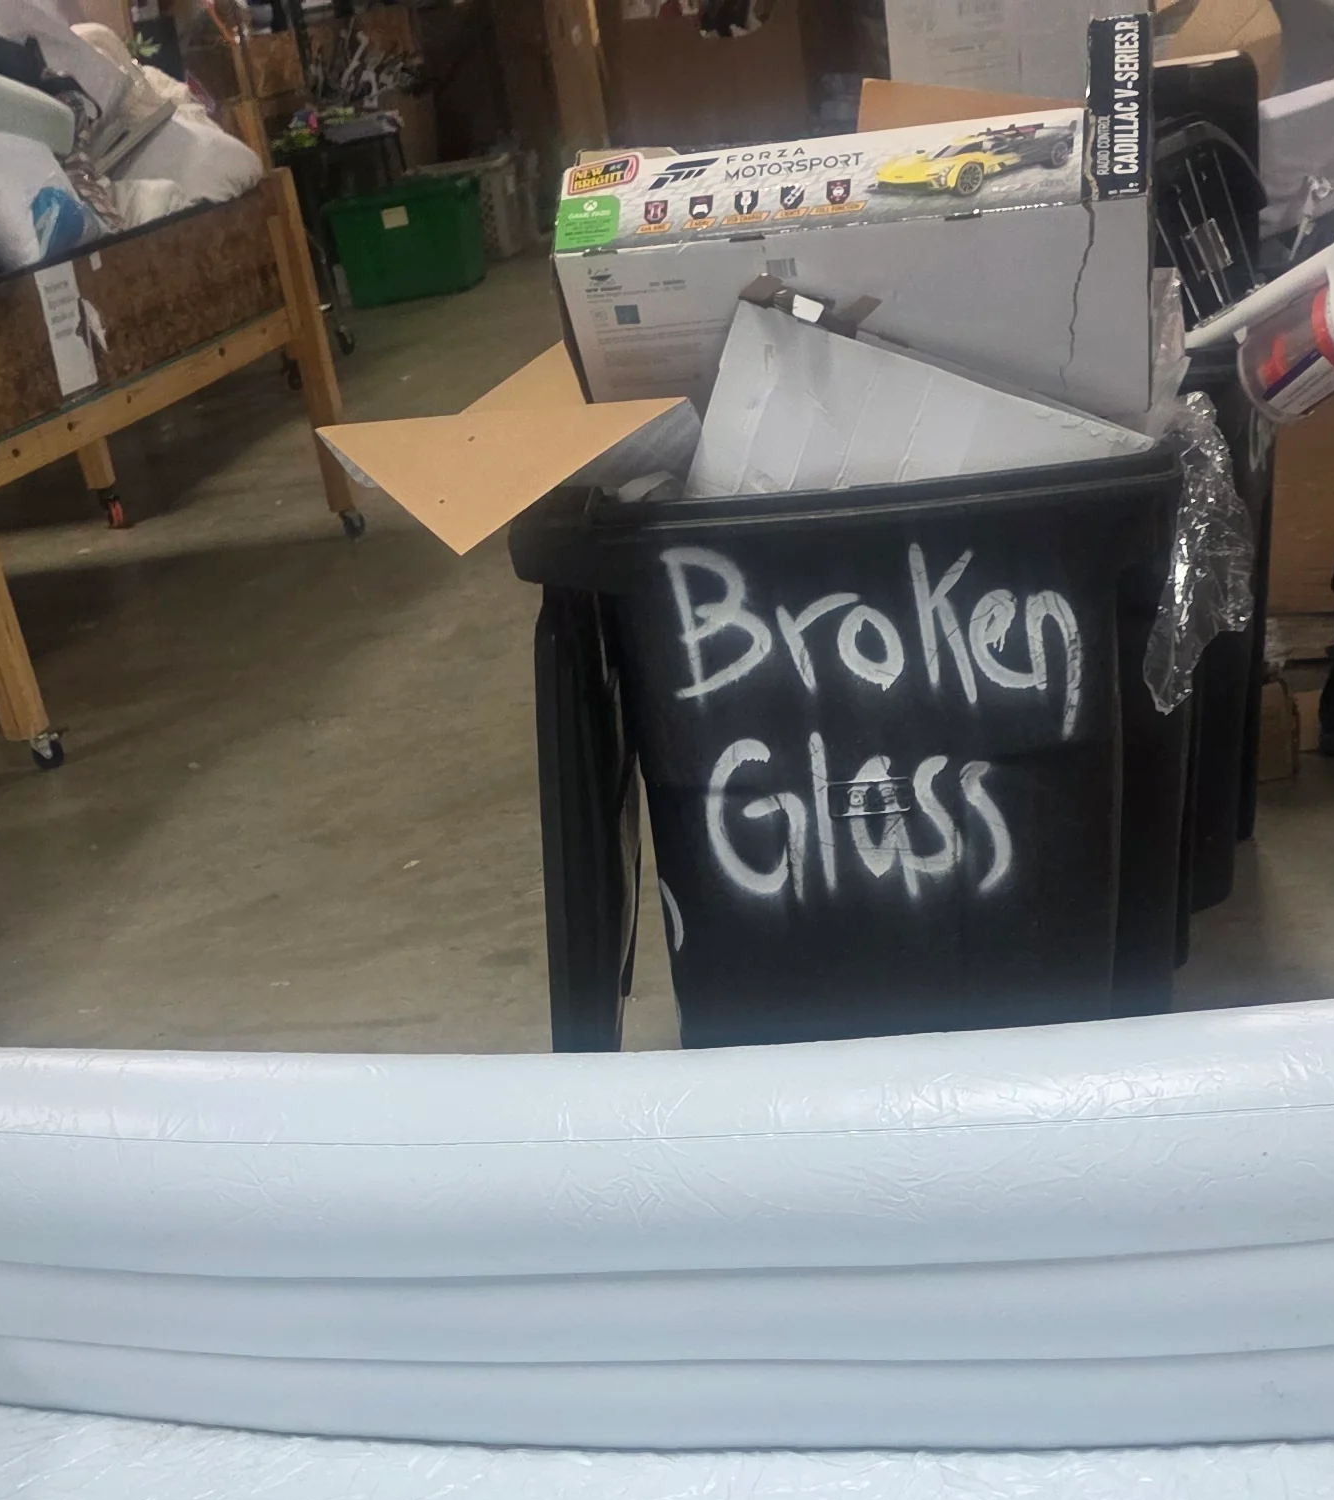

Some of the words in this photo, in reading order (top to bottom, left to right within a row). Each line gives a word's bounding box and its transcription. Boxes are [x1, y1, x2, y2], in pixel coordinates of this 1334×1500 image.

[1113, 20, 1140, 99] V-SERIES.R
[1097, 114, 1111, 149] CONTROL
[1113, 102, 1140, 175] CADILLAC
[724, 152, 865, 182] MOTORSPORT
[726, 146, 806, 165] FORZA
[1096, 150, 1110, 176] RADIO
[573, 171, 624, 190] BRIGHT
[574, 166, 603, 181] NEW
[706, 730, 1013, 899] Glass
